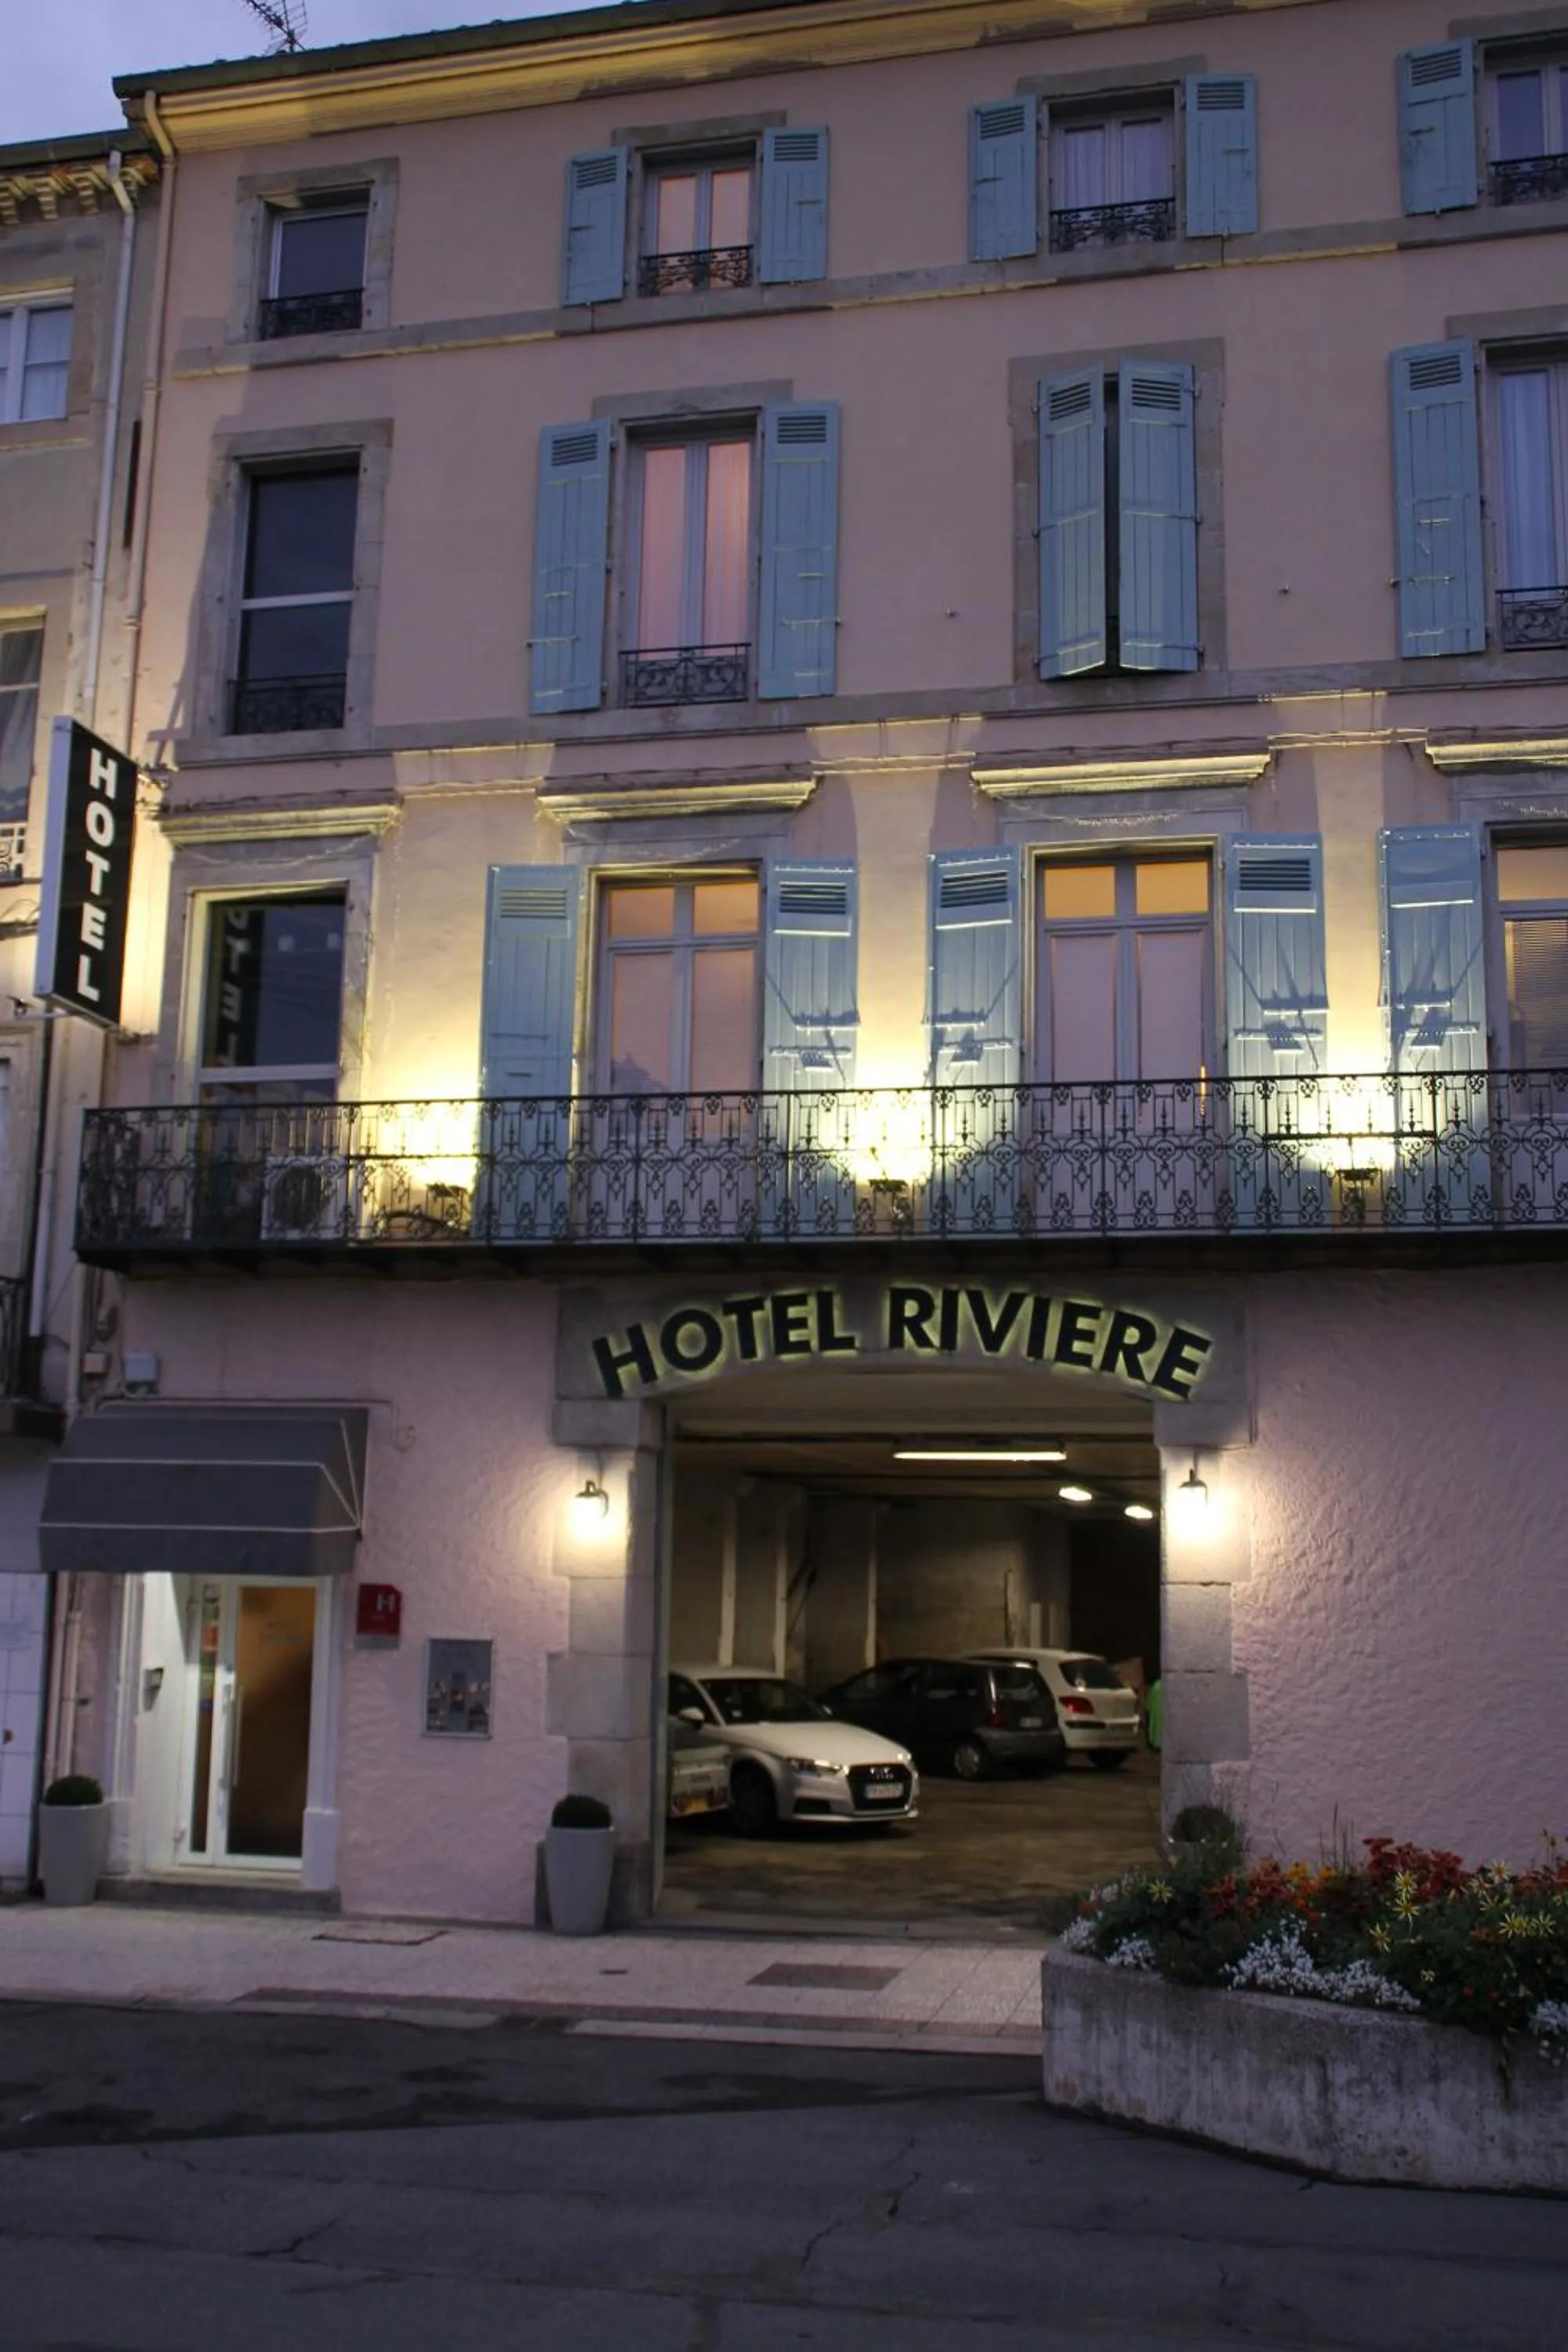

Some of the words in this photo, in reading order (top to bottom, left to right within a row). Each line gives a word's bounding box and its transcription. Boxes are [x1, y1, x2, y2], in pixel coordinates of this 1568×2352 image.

[77, 747, 118, 1004] HOTEL
[591, 1289, 857, 1399] HOTEL
[887, 1286, 1213, 1400] RIVIERE
[376, 1592, 395, 1613] H
